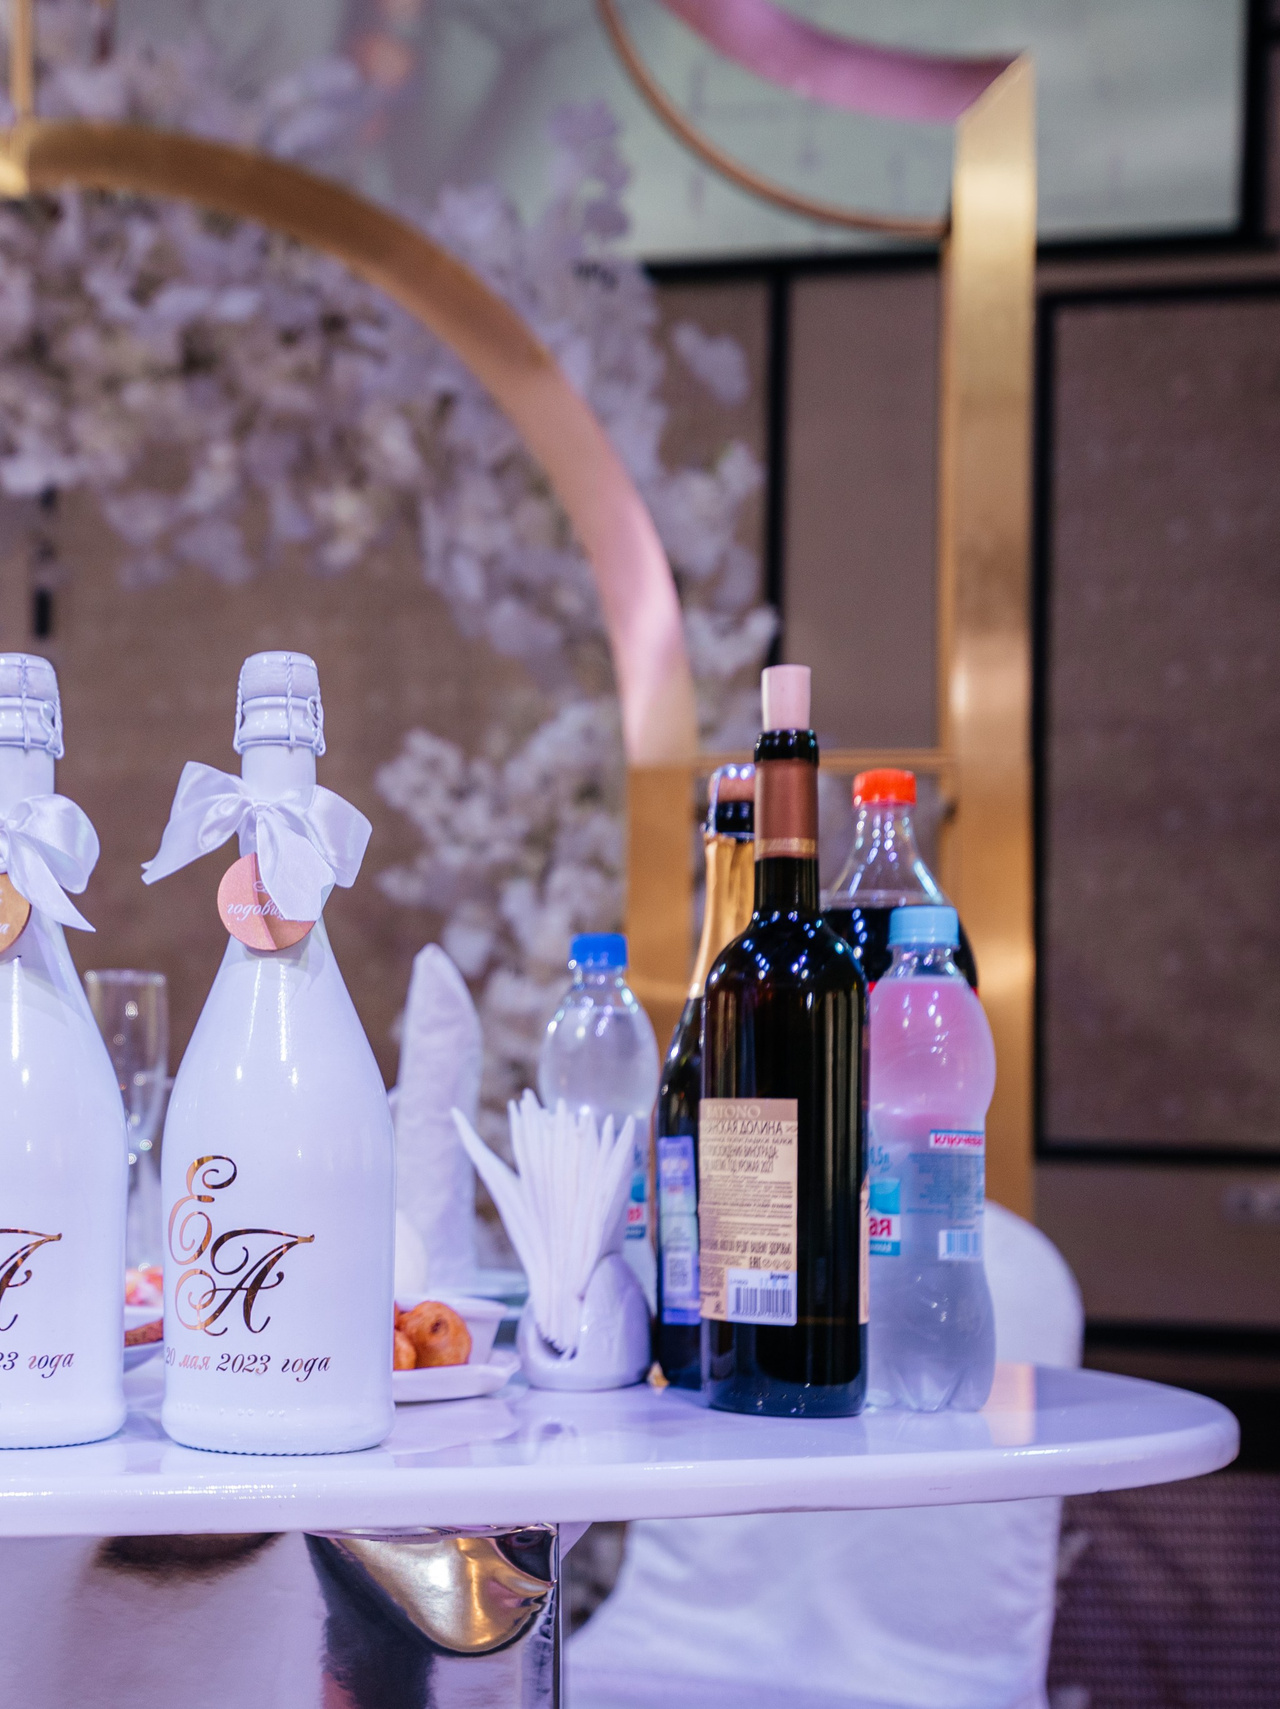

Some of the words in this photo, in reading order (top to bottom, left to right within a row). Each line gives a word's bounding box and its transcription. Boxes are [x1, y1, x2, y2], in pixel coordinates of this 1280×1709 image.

[739, 1120, 783, 1136] ДОЛИНА
[27, 1352, 75, 1379] года
[165, 1346, 176, 1366] 20
[178, 1353, 211, 1371] мая
[216, 1352, 272, 1374] 2023
[281, 1355, 332, 1383] года
